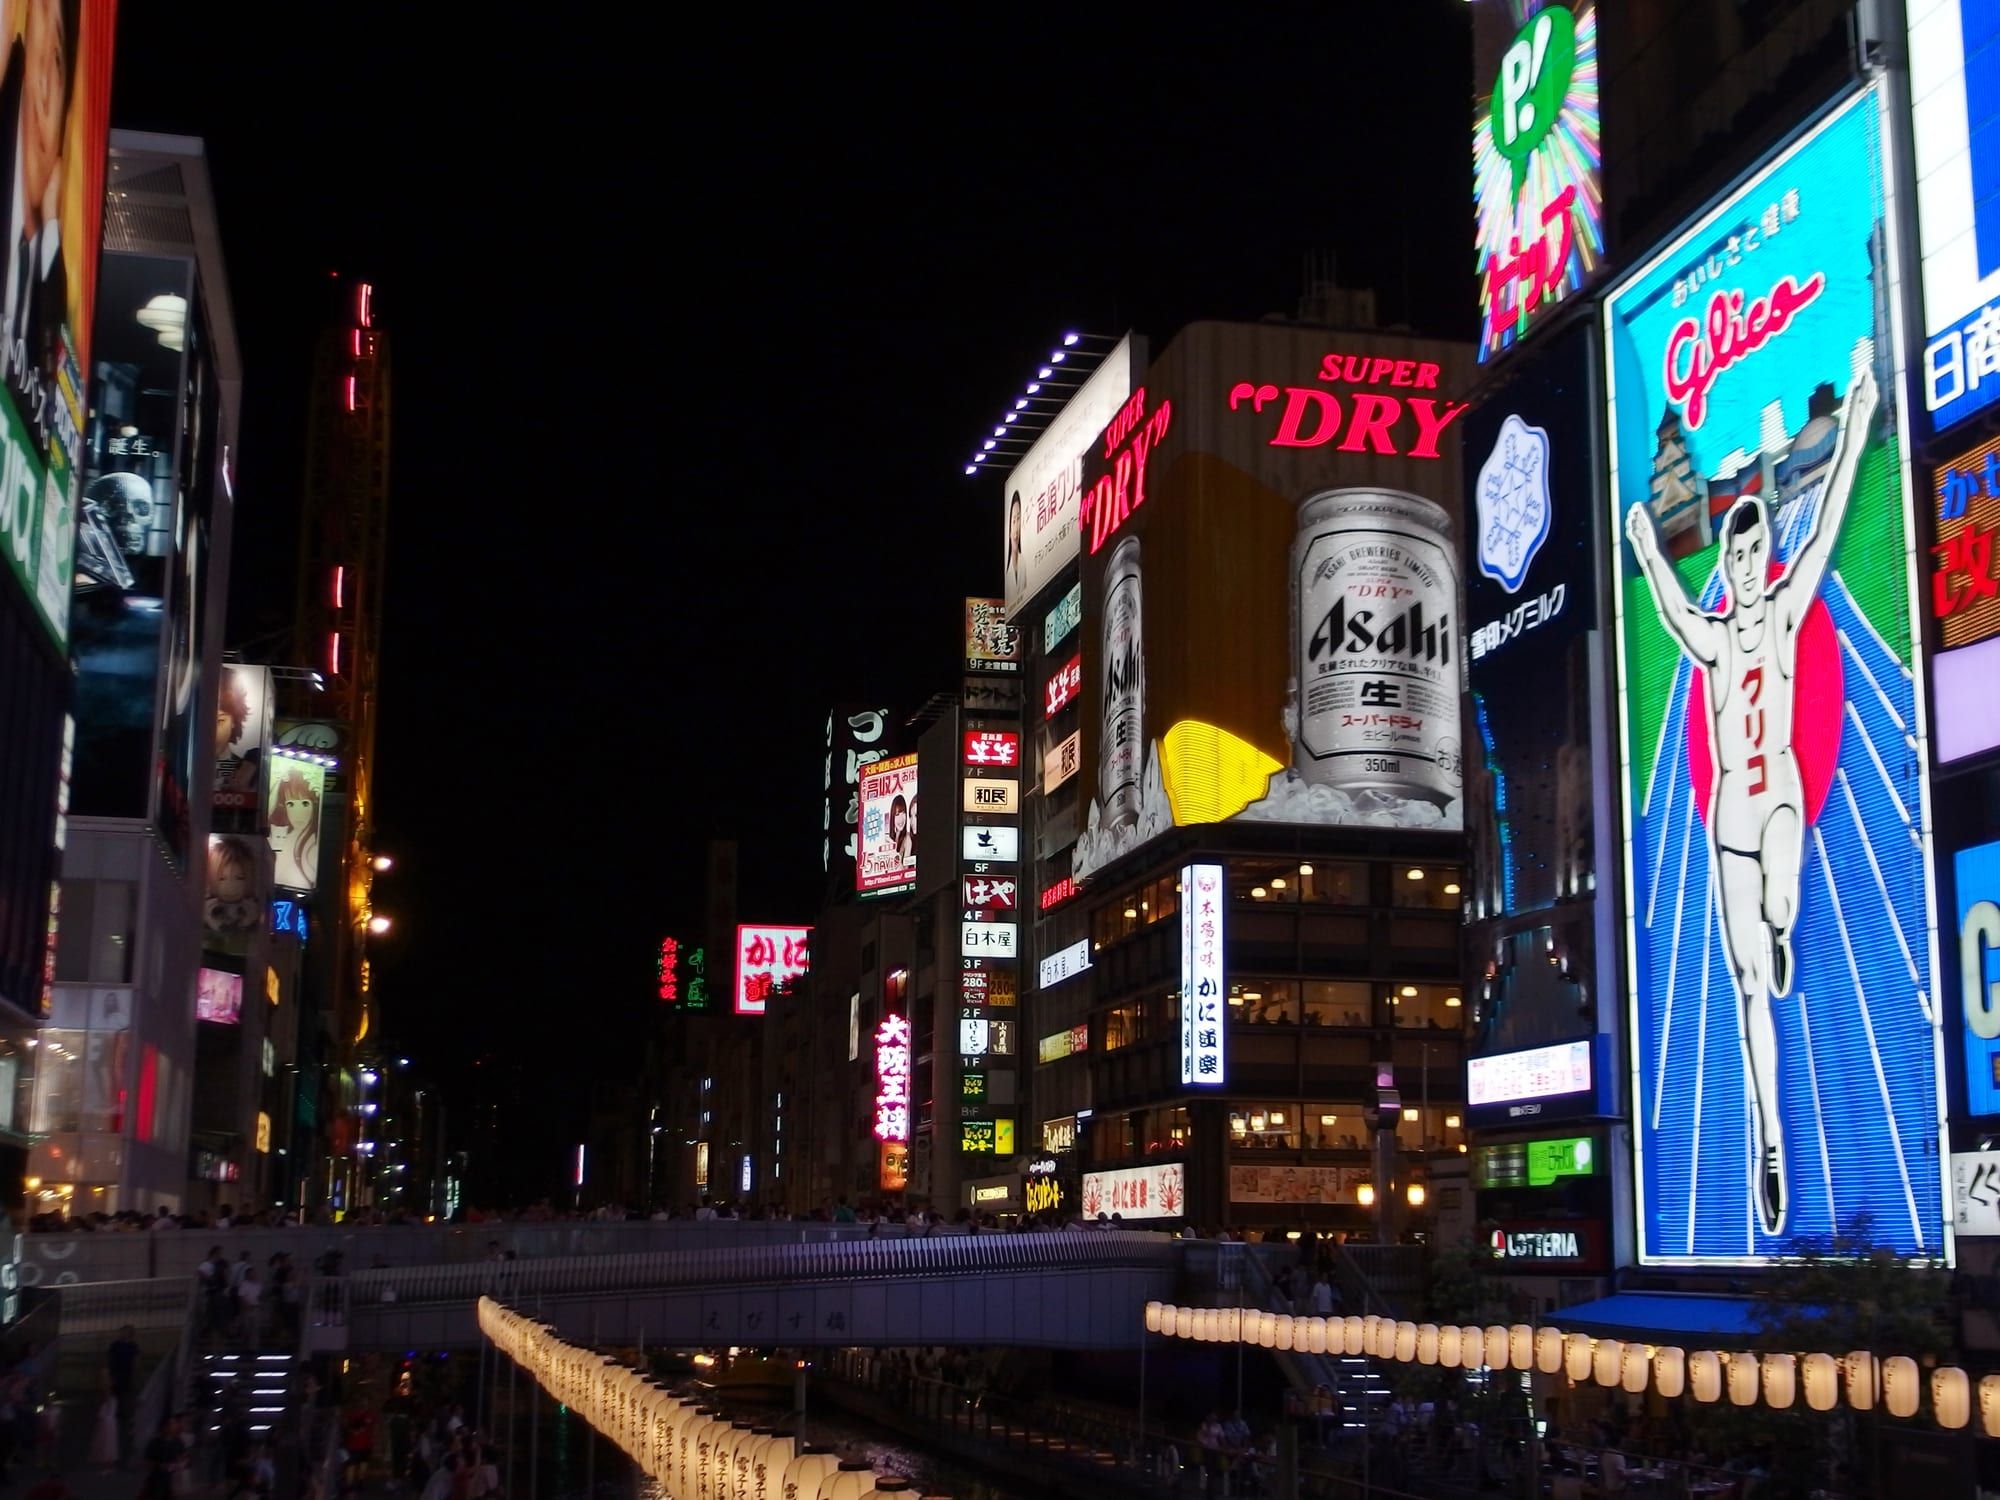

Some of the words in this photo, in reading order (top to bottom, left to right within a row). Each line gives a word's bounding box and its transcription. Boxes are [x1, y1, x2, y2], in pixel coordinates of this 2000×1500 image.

[1663, 271, 1827, 433] Glico
[1319, 353, 1441, 388] SUPER
[1104, 386, 1145, 459] SUPER
[1324, 555, 1346, 580] ASAHI
[1349, 546, 1401, 562] BREWERIES
[1403, 556, 1434, 588] LIMITED
[1308, 595, 1449, 667] Asahi
[1470, 583, 1566, 661] 雪印メグミルク
[970, 659, 984, 670] 9F
[1360, 680, 1402, 708] 生
[1341, 714, 1423, 731] スーパードライ
[1365, 758, 1401, 774] 350ml
[976, 788, 1006, 803] 和民
[974, 862, 988, 873] 5F
[964, 910, 983, 920] 4F
[966, 928, 1013, 947] 白木屋
[963, 959, 982, 969] 3F
[963, 1008, 981, 1018] 2F
[1198, 976, 1217, 1075] かに道楽
[963, 1057, 980, 1067] 1F
[875, 1013, 908, 1140] 大阪王将
[1507, 1232, 1579, 1258] LOTTERIA
